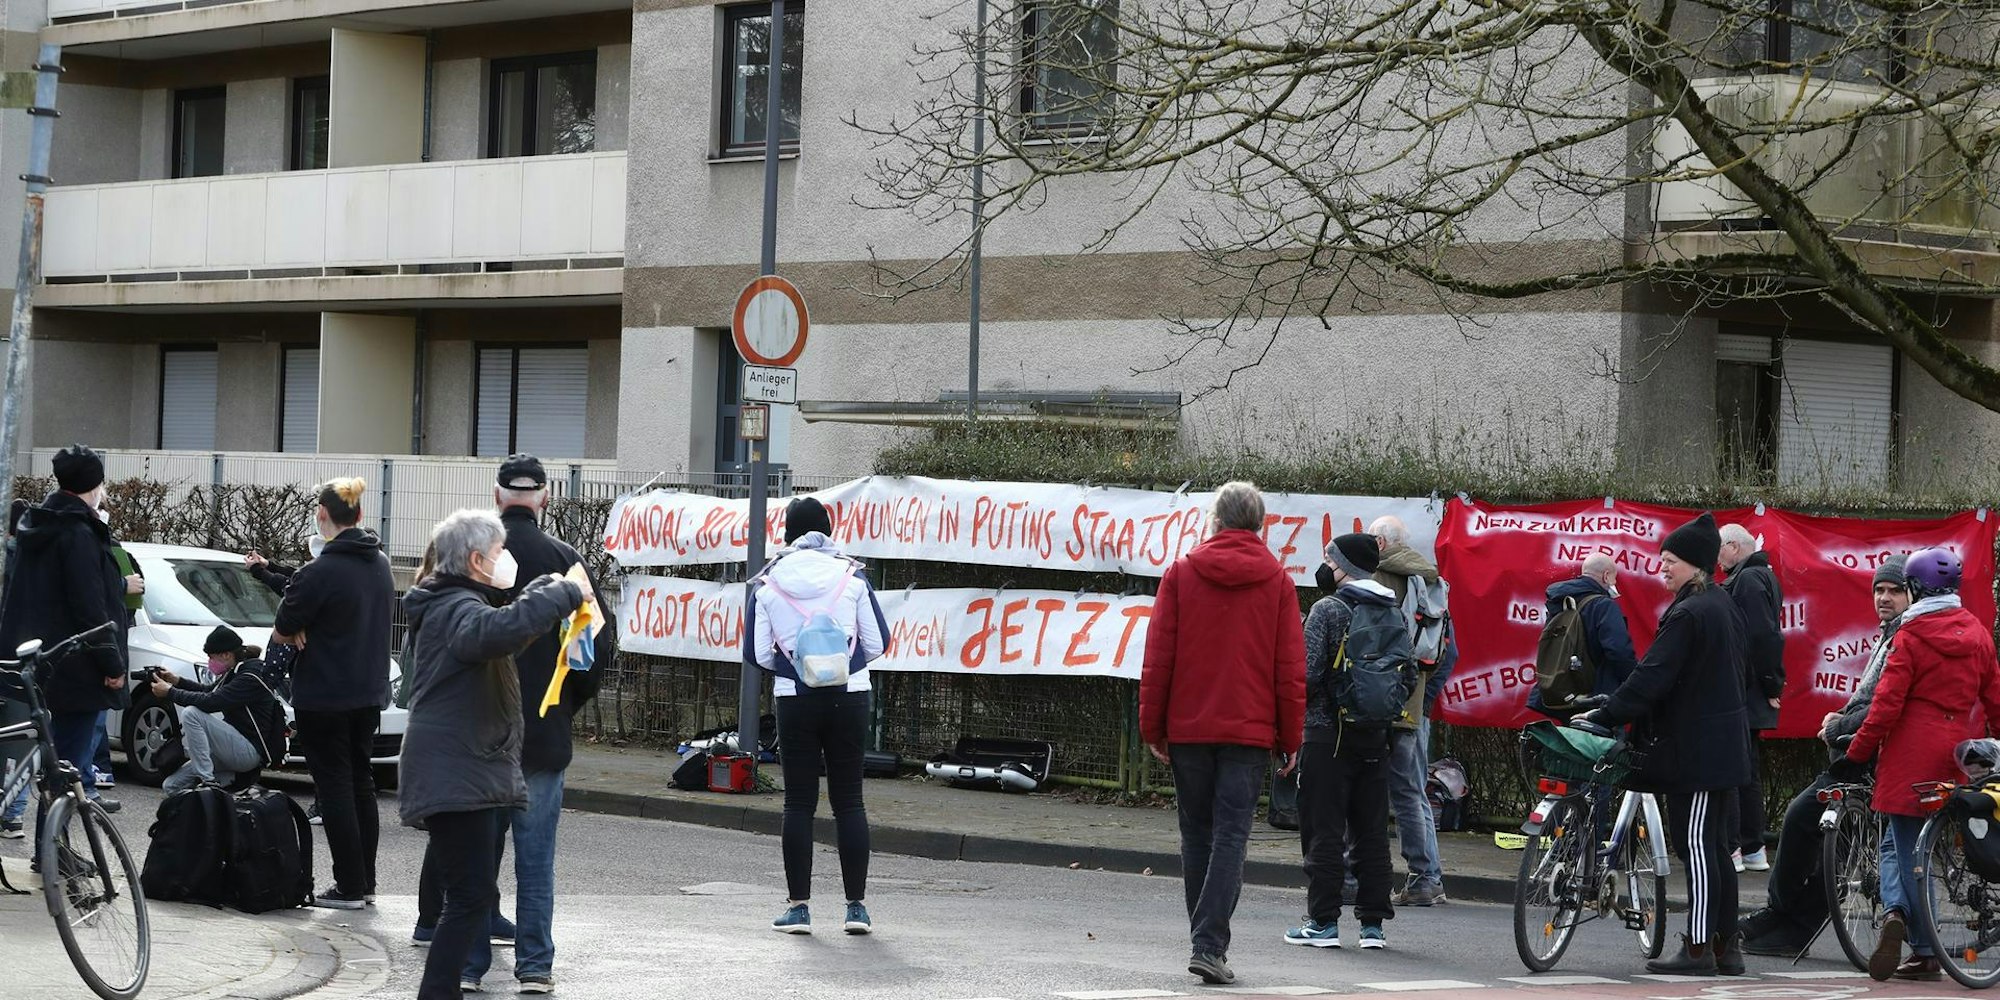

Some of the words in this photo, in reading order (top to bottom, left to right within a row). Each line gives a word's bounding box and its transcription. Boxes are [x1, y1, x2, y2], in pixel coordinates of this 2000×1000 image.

[750, 372, 791, 386] Anlieger
[761, 386, 778, 398] frei
[1475, 514, 1523, 531] NEIN
[1527, 515, 1576, 533] ZUM
[1580, 515, 1655, 538] KRIEG!
[1558, 544, 1592, 561] NE
[1815, 672, 1849, 692] NIE
